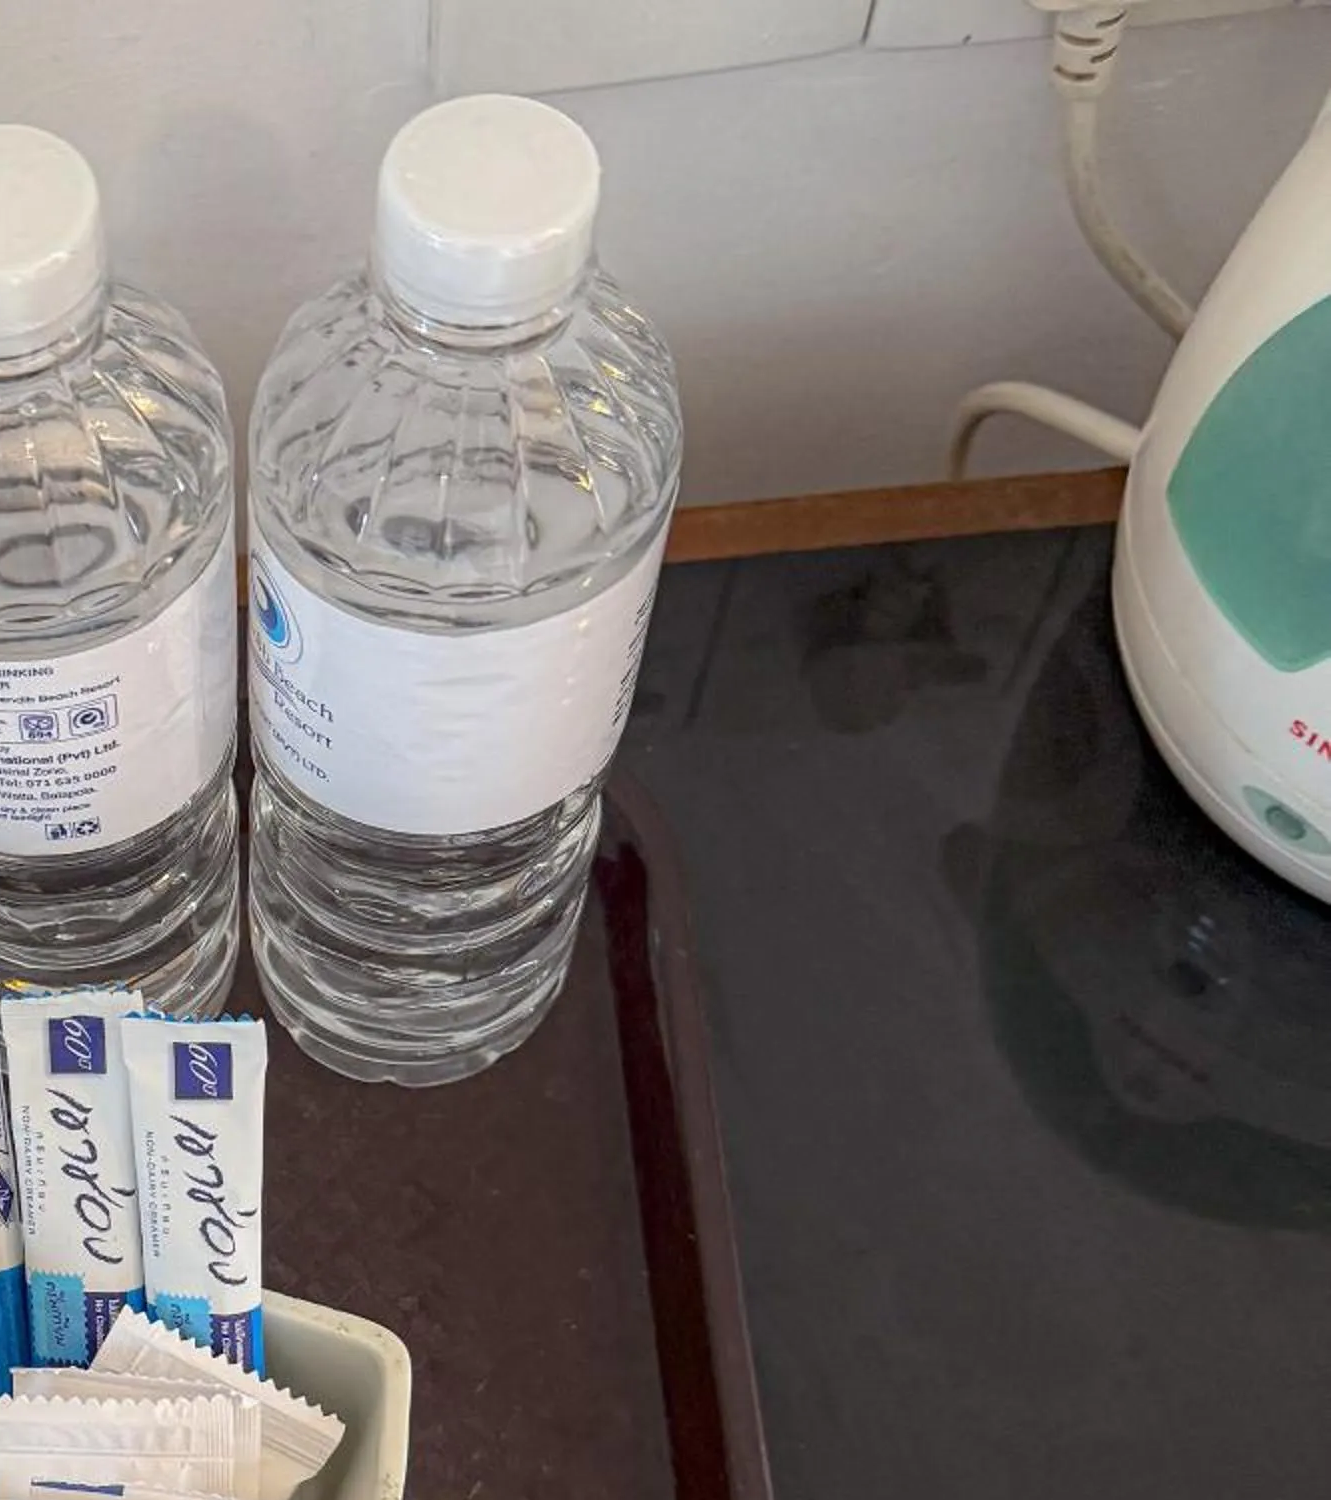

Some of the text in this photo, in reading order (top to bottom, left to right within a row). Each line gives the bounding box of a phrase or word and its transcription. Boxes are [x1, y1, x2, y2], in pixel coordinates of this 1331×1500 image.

[80, 675, 120, 694] Resort
[56, 747, 91, 765] (Pvt)
[83, 763, 117, 782] 0000
